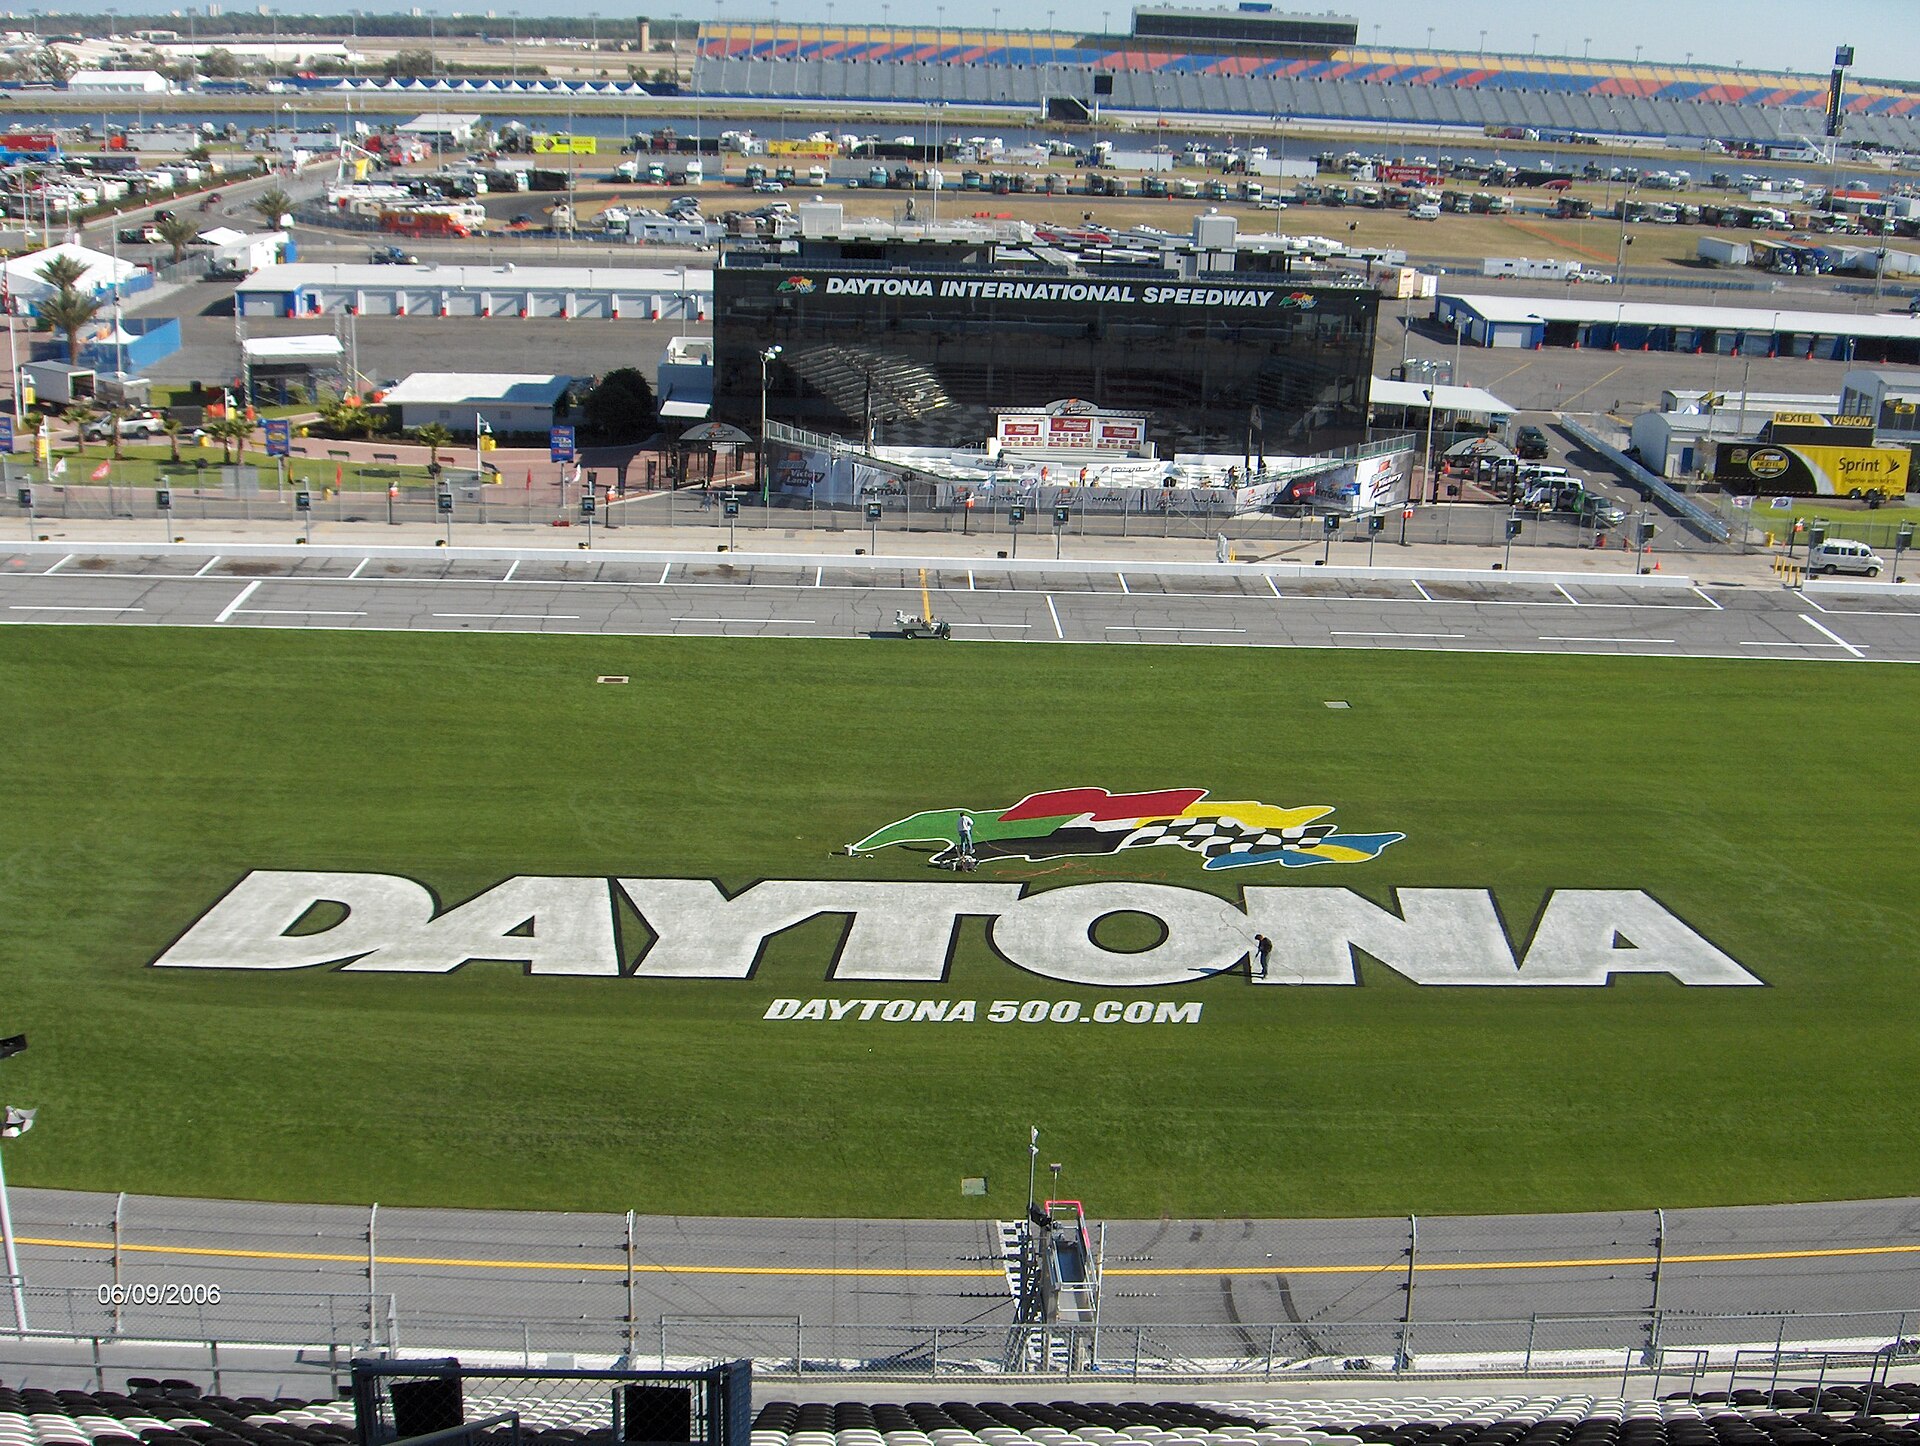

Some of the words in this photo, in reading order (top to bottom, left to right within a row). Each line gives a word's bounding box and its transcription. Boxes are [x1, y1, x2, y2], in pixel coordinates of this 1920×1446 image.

[826, 277, 933, 297] DAYTONA
[940, 280, 1135, 302] INTERNATIONAL
[1142, 286, 1274, 308] SPEEDWAY
[1775, 413, 1815, 424] NEXTEL
[1832, 415, 1871, 427] VISION
[1838, 456, 1880, 474] Sprint
[786, 475, 808, 484] Lane
[790, 469, 823, 480] Victory
[861, 487, 907, 496] DAYTONA
[150, 868, 1766, 988] DAYTONA
[762, 998, 976, 1023] DAYTONA
[987, 999, 1203, 1024] 500.COM
